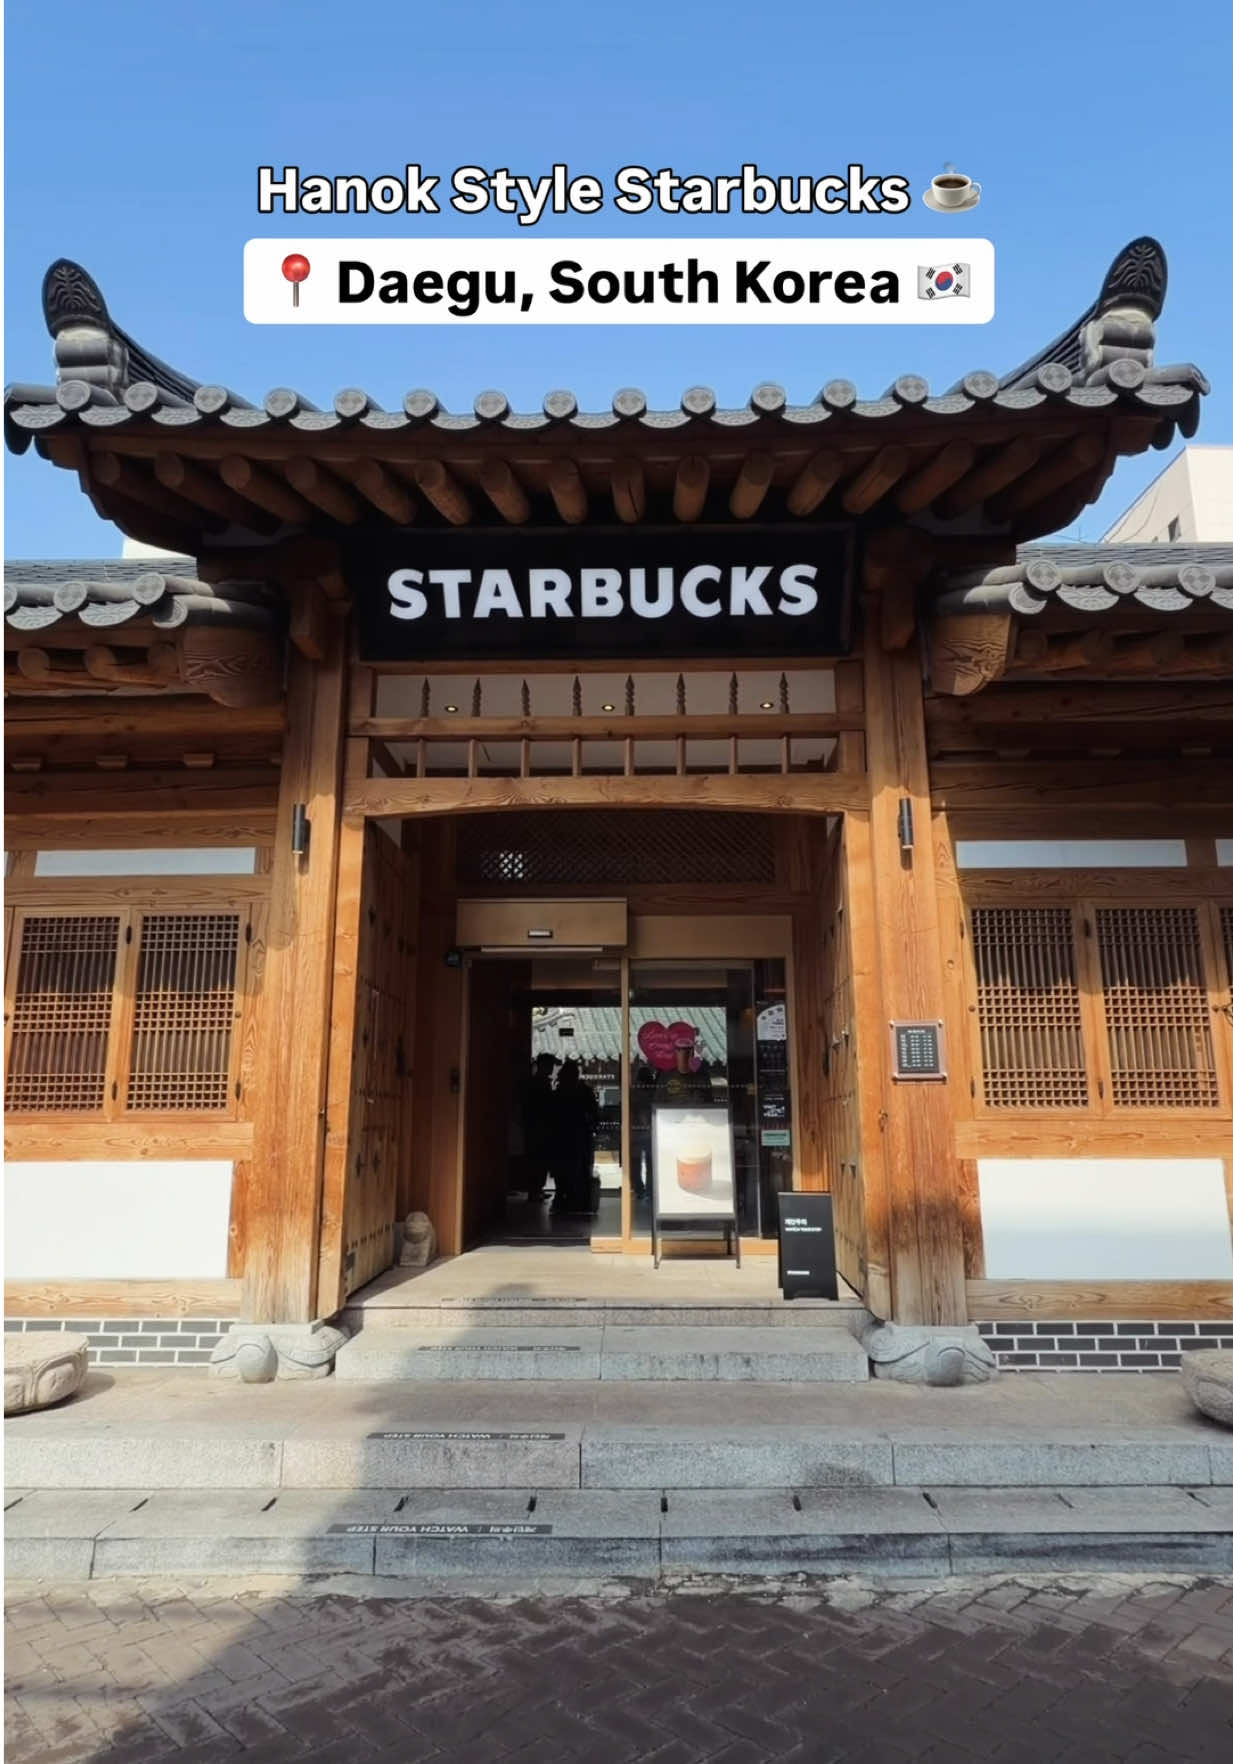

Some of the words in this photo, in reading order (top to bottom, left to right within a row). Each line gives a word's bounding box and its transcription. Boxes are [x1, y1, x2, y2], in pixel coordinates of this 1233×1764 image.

[387, 564, 818, 620] STARBUCKS
[346, 1525, 377, 1533] STEP
[379, 1525, 417, 1533] YOUR
[419, 1525, 469, 1533] WATCH
